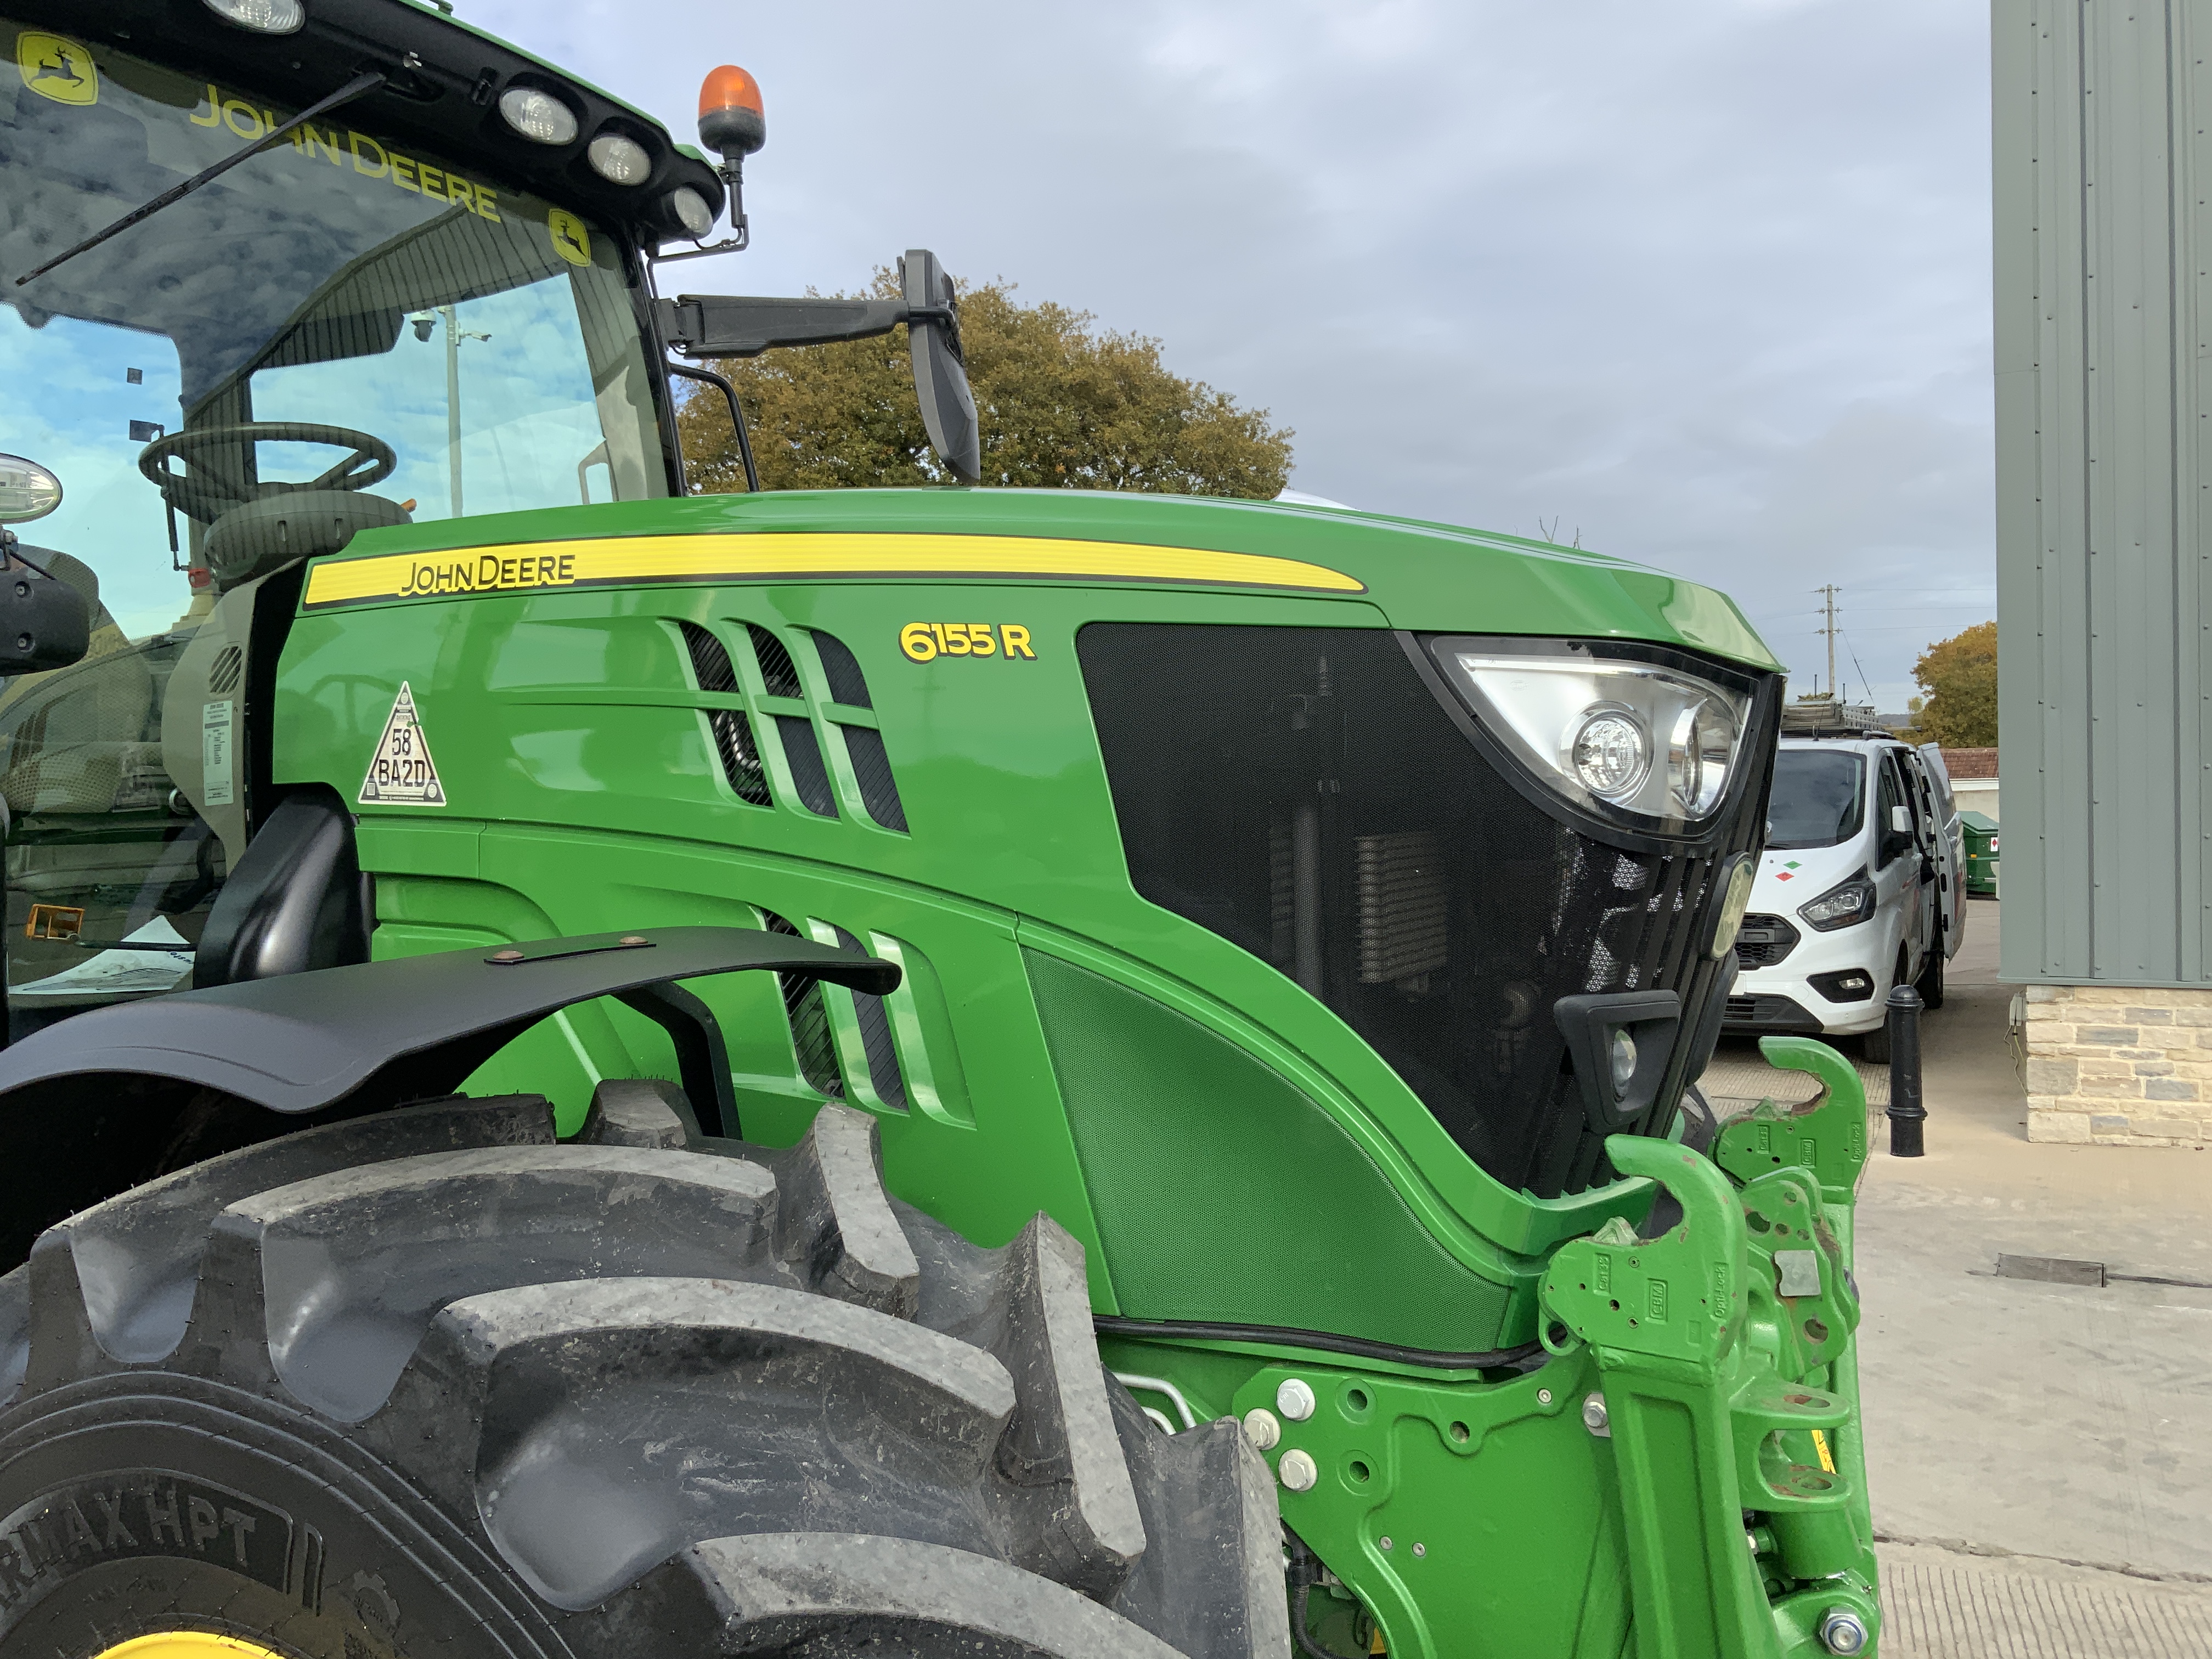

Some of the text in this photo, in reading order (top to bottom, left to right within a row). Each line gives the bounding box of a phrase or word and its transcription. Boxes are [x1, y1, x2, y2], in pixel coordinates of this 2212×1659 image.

[348, 129, 501, 223] DEERE
[401, 554, 576, 592] JOHN DEERE
[899, 621, 1038, 664] 6155 R
[392, 728, 411, 756] 58
[379, 759, 425, 787] BA2D
[1803, 1143, 1812, 1163] CBM
[1652, 1285, 1663, 1314] CBM
[1713, 1266, 1726, 1318] Opti-Lock
[0, 1485, 257, 1609] RMAX HPT
